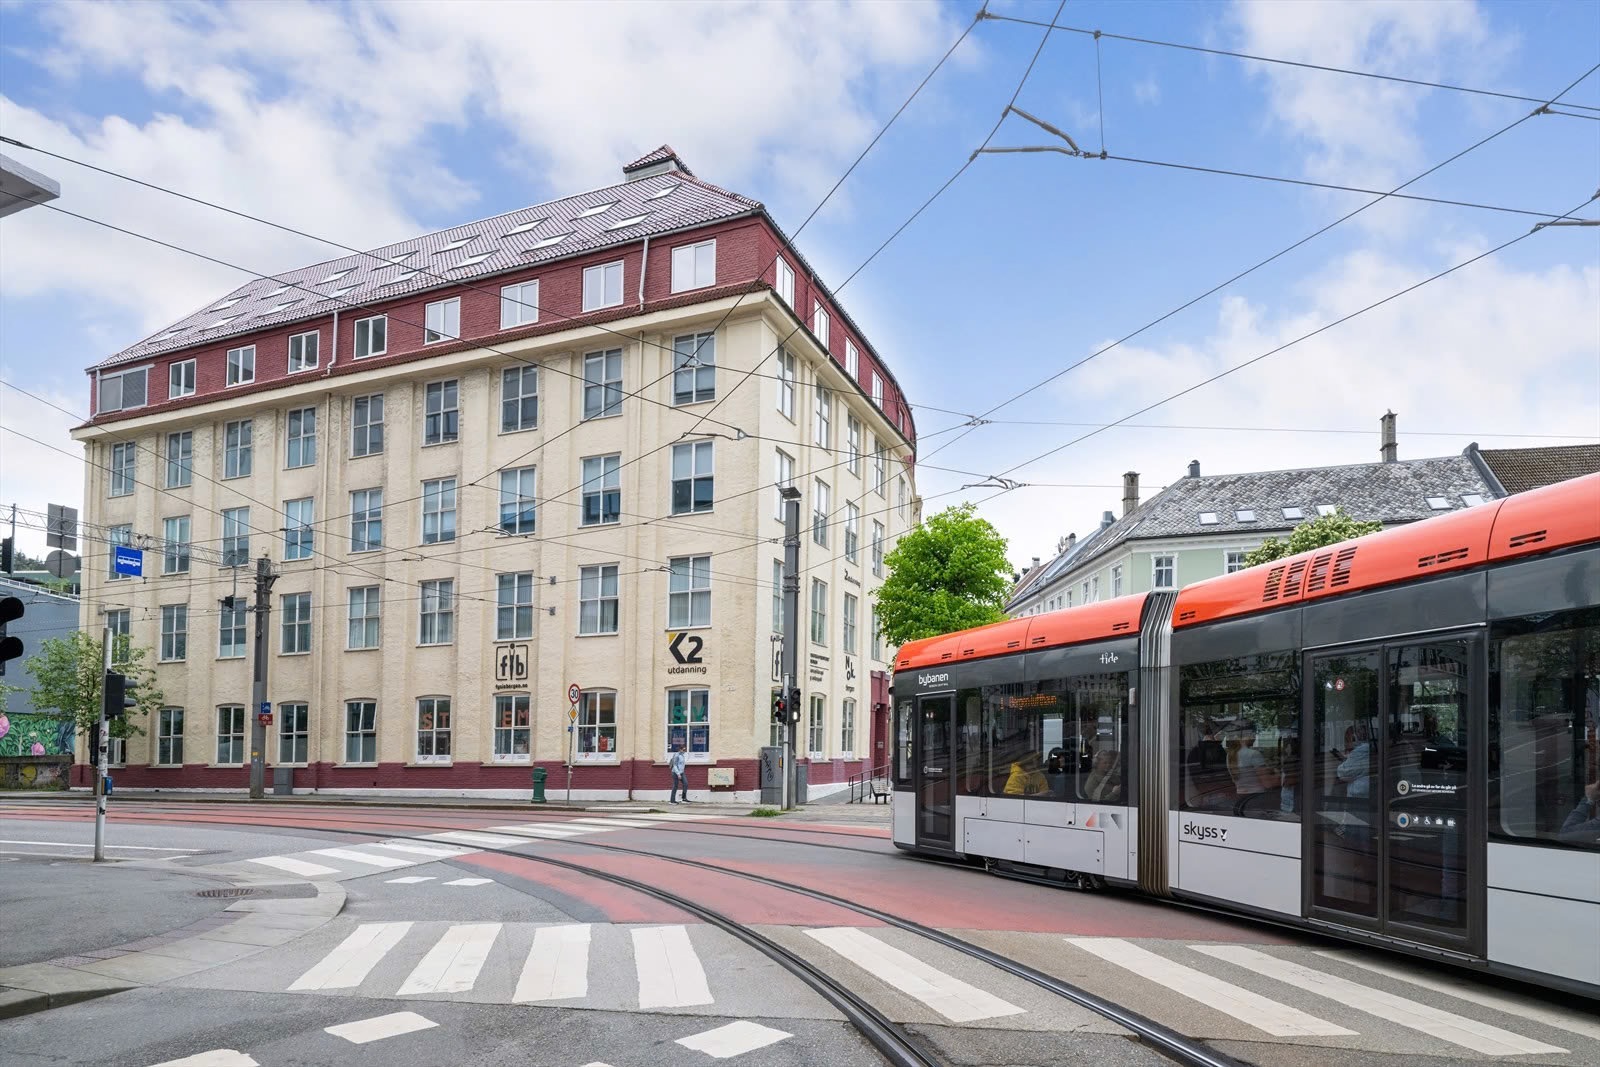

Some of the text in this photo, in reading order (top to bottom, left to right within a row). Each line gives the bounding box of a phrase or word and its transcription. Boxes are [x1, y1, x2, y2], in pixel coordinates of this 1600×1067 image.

[668, 632, 704, 664] K2
[1100, 652, 1118, 664] tide
[668, 666, 707, 674] utdanning
[918, 673, 948, 686] bybanen
[570, 688, 579, 699] 30
[1184, 821, 1218, 840] skyss
